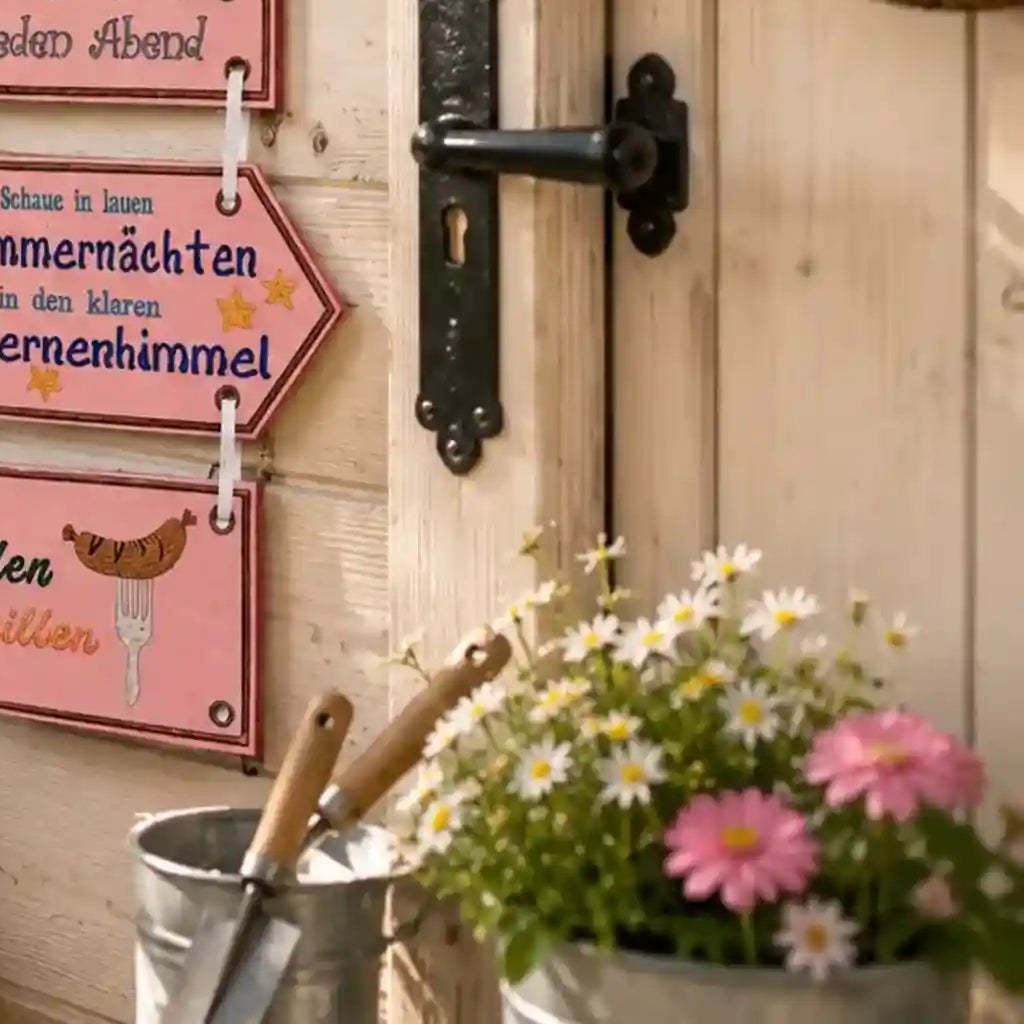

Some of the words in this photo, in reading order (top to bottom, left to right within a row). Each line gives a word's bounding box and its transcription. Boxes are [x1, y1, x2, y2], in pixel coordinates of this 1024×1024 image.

[88, 14, 208, 62] Abend
[0, 185, 64, 214] Schaue
[74, 189, 92, 213] in
[102, 189, 154, 215] lauen
[32, 287, 73, 314] den
[87, 289, 162, 319] klaren
